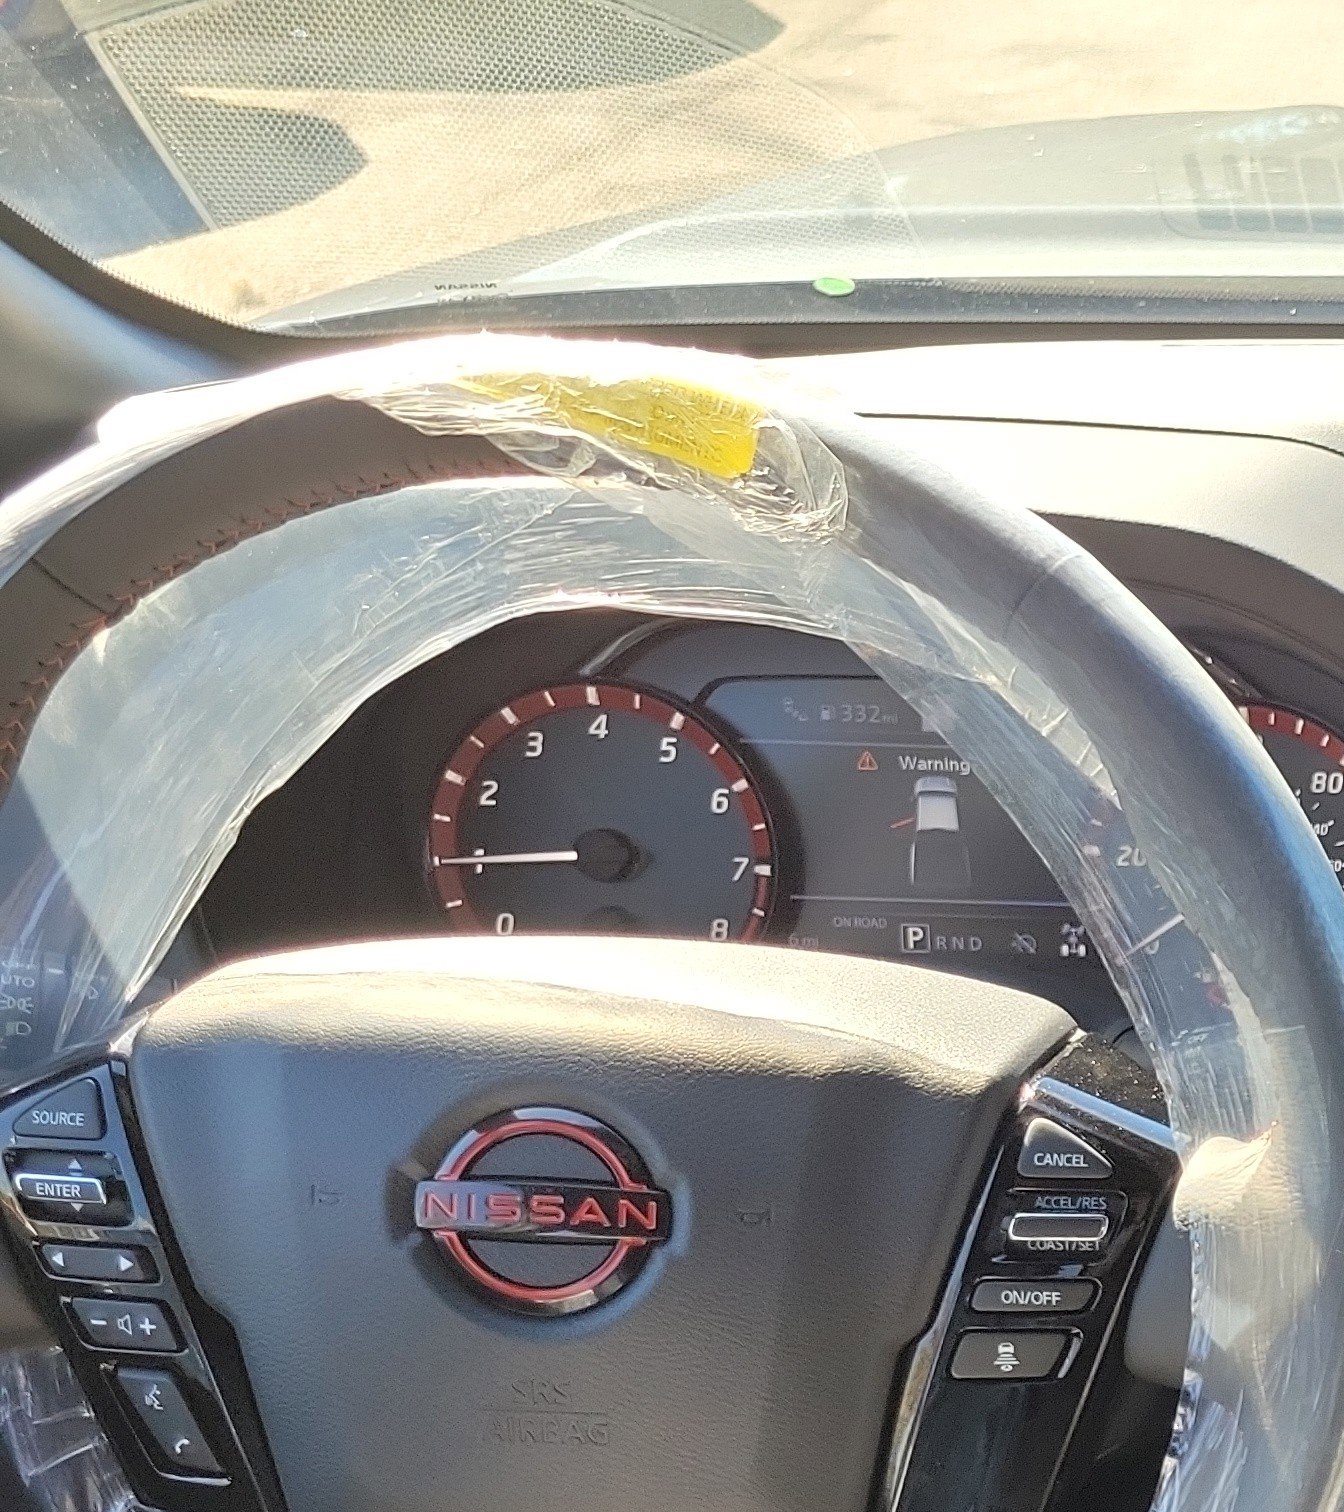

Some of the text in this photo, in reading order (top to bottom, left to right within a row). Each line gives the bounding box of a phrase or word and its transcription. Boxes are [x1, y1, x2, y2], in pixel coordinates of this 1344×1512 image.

[841, 705, 881, 723] 332
[588, 714, 609, 739] 4
[524, 731, 544, 757] 3
[659, 737, 677, 763] 5
[899, 755, 971, 776] Warning
[479, 780, 499, 806] 2
[1310, 772, 1344, 794] 80
[711, 788, 730, 814] 6
[1115, 846, 1147, 867] 20
[732, 857, 749, 882] 7
[495, 912, 515, 936] 0
[710, 918, 729, 941] 8
[853, 917, 888, 929] ROAD
[906, 927, 982, 950] P R N D
[32, 1110, 85, 1127] SOURCE
[1033, 1153, 1089, 1168] CANCEL
[36, 1182, 82, 1198] ENTER
[421, 1191, 658, 1231] NISSAN
[1034, 1196, 1107, 1210] ACCEL/RES
[1028, 1239, 1100, 1251] COAST/SET
[1001, 1290, 1061, 1305] ON/OFF
